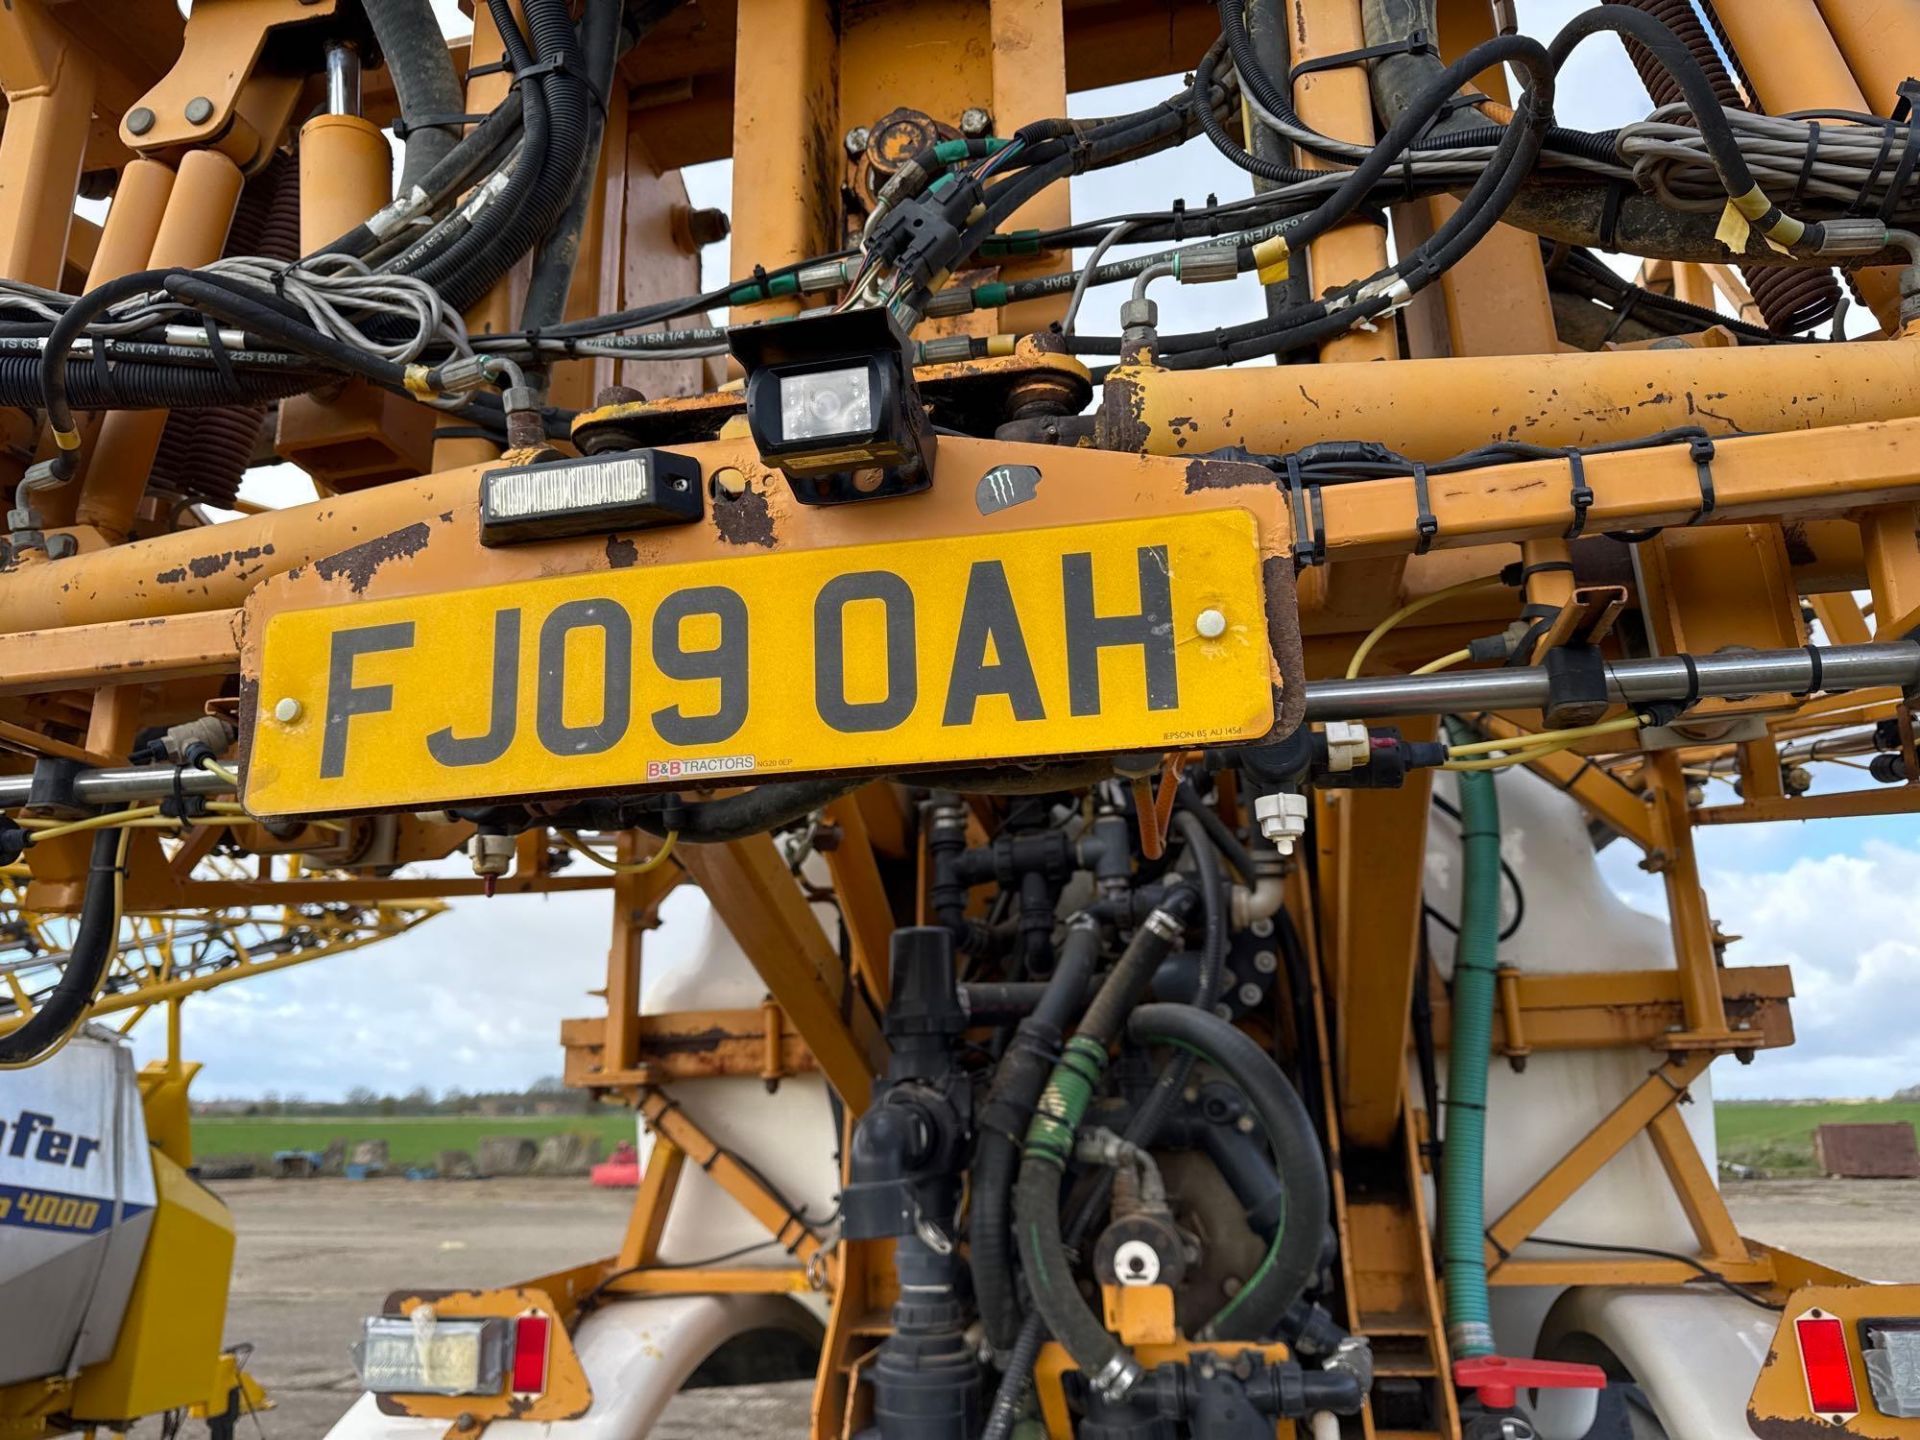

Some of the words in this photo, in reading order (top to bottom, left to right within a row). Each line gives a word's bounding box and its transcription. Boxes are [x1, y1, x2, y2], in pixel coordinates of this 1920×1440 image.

[1043, 275, 1071, 290] BAR
[617, 335, 639, 347] 853
[642, 331, 666, 344] 1SN
[693, 327, 722, 340] Max.
[168, 345, 201, 358] Max.
[229, 350, 254, 362] 225
[256, 352, 289, 363] BAR
[319, 585, 750, 780] FJ09
[813, 544, 1180, 734] OAH
[683, 756, 754, 773] TRACTORS
[16, 1191, 101, 1230] 4000
